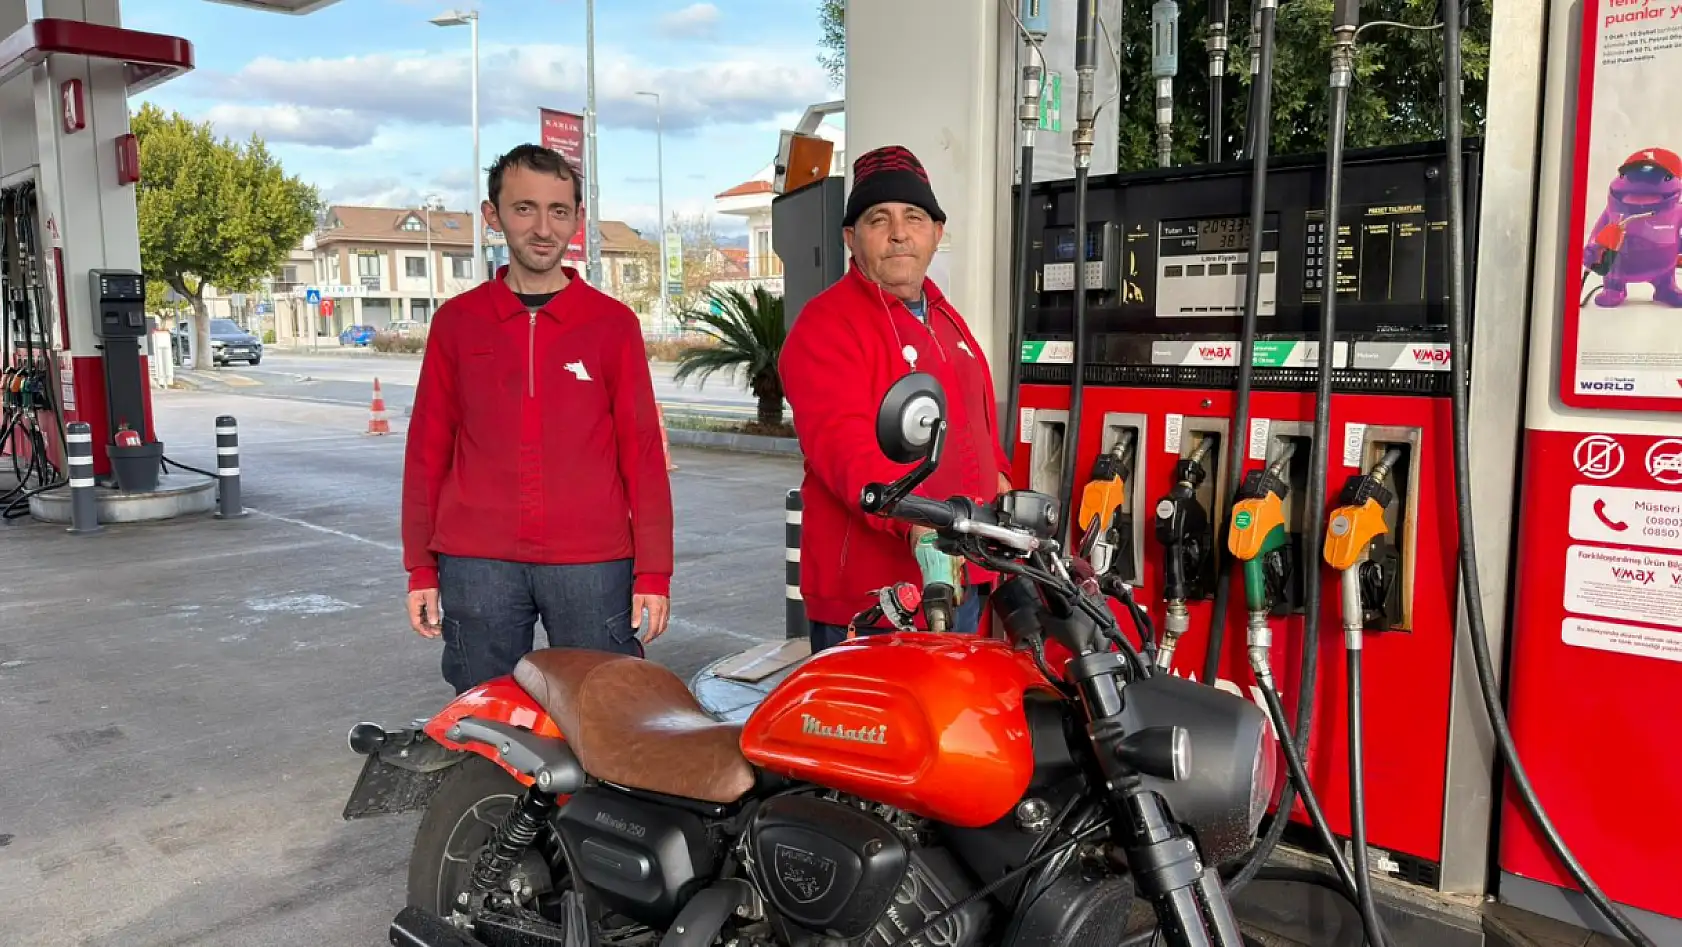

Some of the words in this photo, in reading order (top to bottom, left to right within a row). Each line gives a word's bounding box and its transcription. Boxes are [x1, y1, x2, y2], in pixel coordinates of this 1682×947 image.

[1604, 7, 1665, 28] puanlar
[1580, 381, 1635, 391] WORLD
[1642, 527, 1680, 538] (0850)
[1643, 556, 1665, 567] Ürün
[801, 712, 888, 745] Musatti
[627, 822, 646, 838] 250
